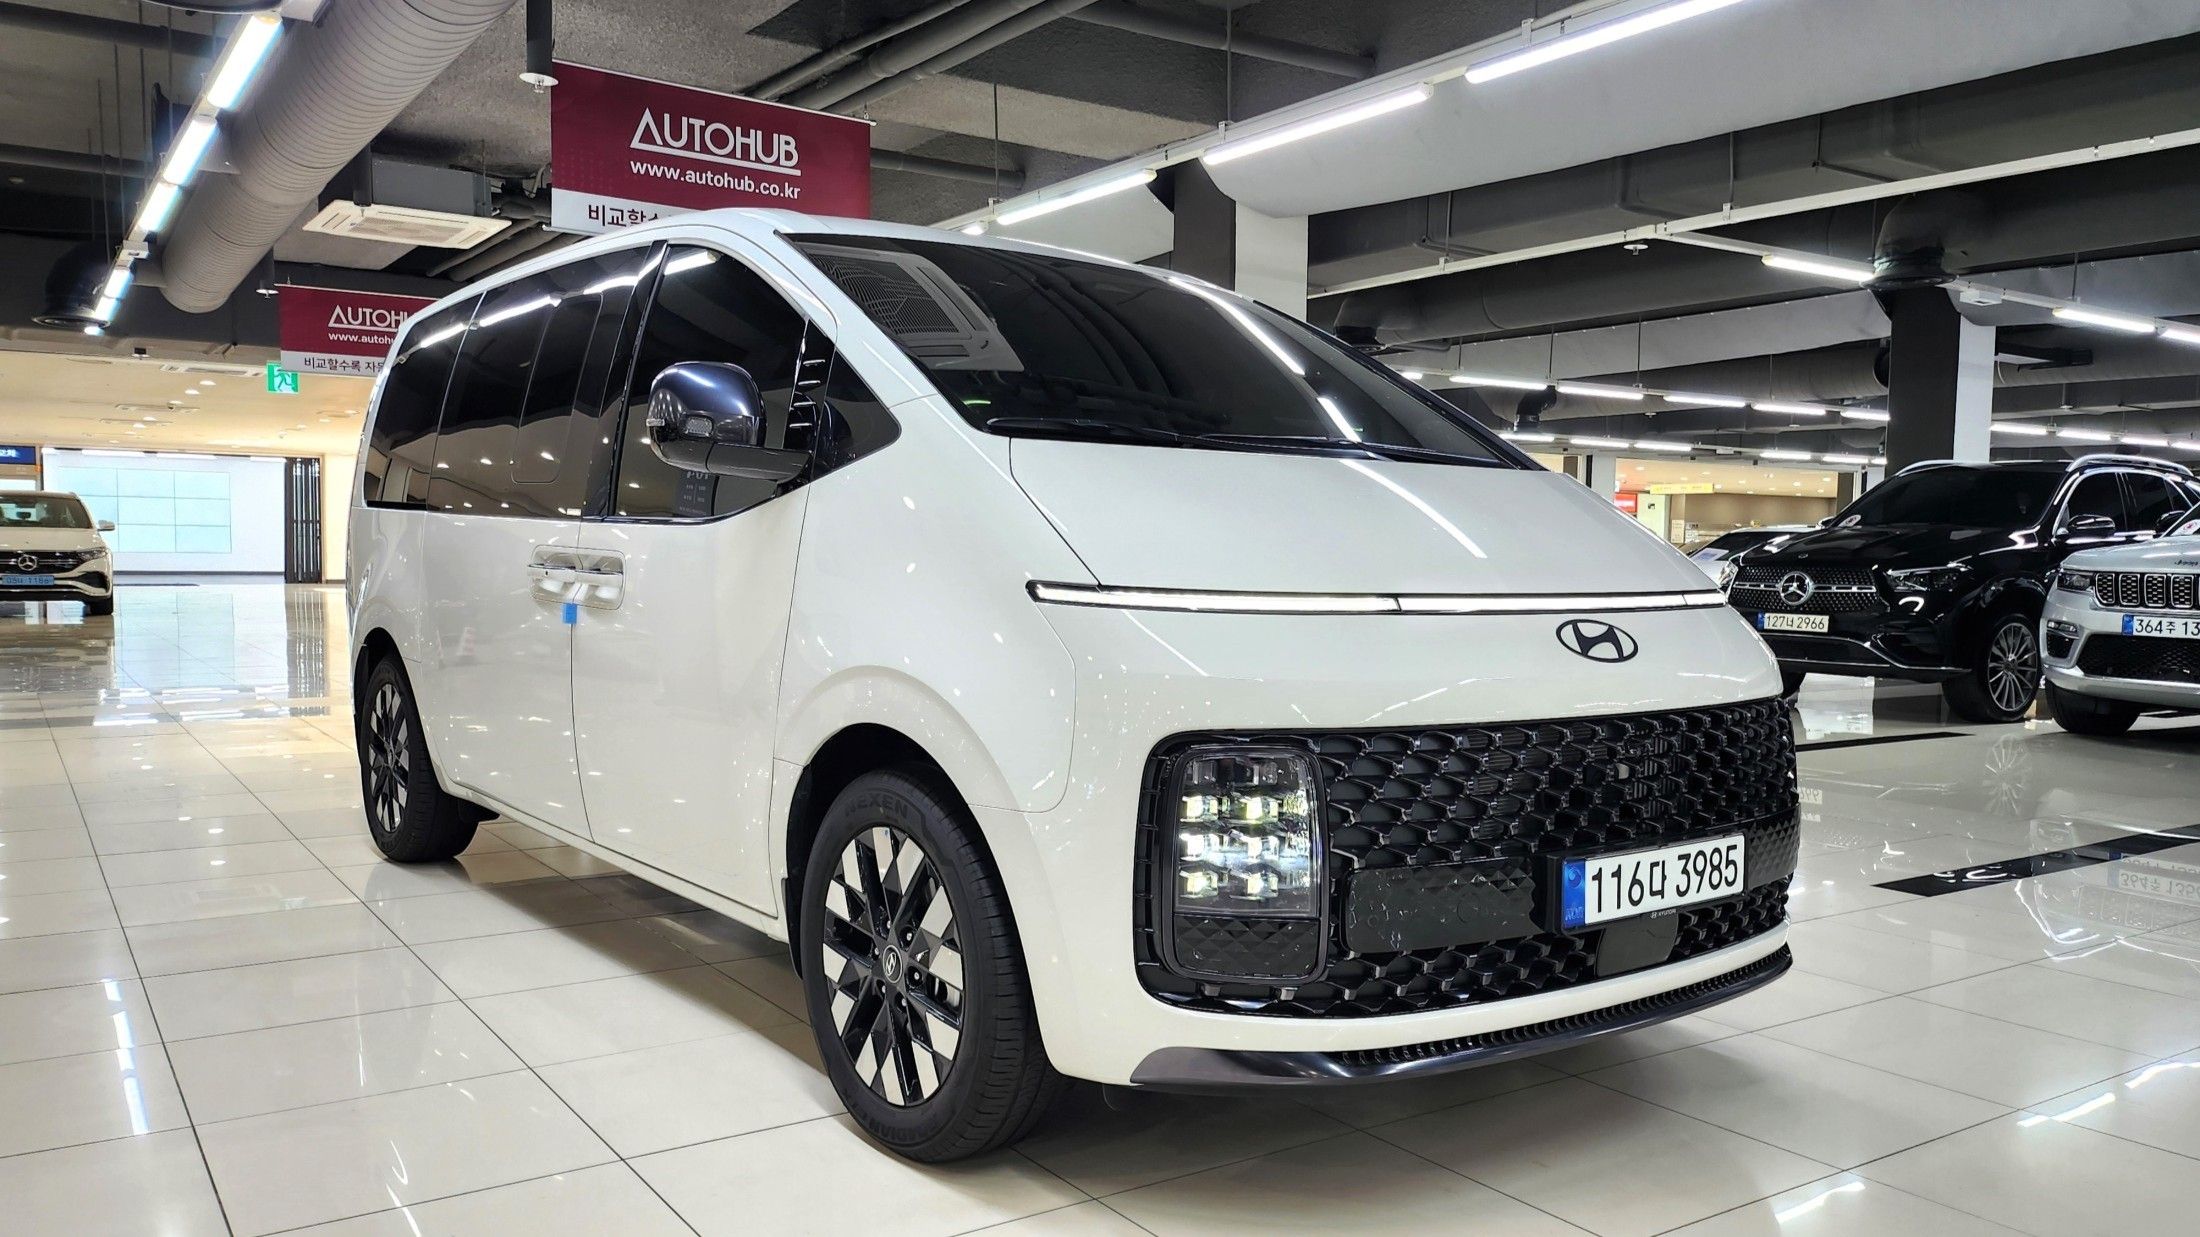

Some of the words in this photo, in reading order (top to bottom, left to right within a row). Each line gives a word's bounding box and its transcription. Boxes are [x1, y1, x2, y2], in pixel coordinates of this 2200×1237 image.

[630, 107, 801, 176] AUTOHUB
[630, 160, 800, 200] www.autohub.co.kr
[304, 356, 361, 371] 비교할수록
[1766, 615, 1794, 628] 127너
[1796, 616, 1825, 630] 2966
[2135, 619, 2176, 634] 364주
[1591, 860, 1667, 913] 116다
[1675, 844, 1738, 897] 3985
